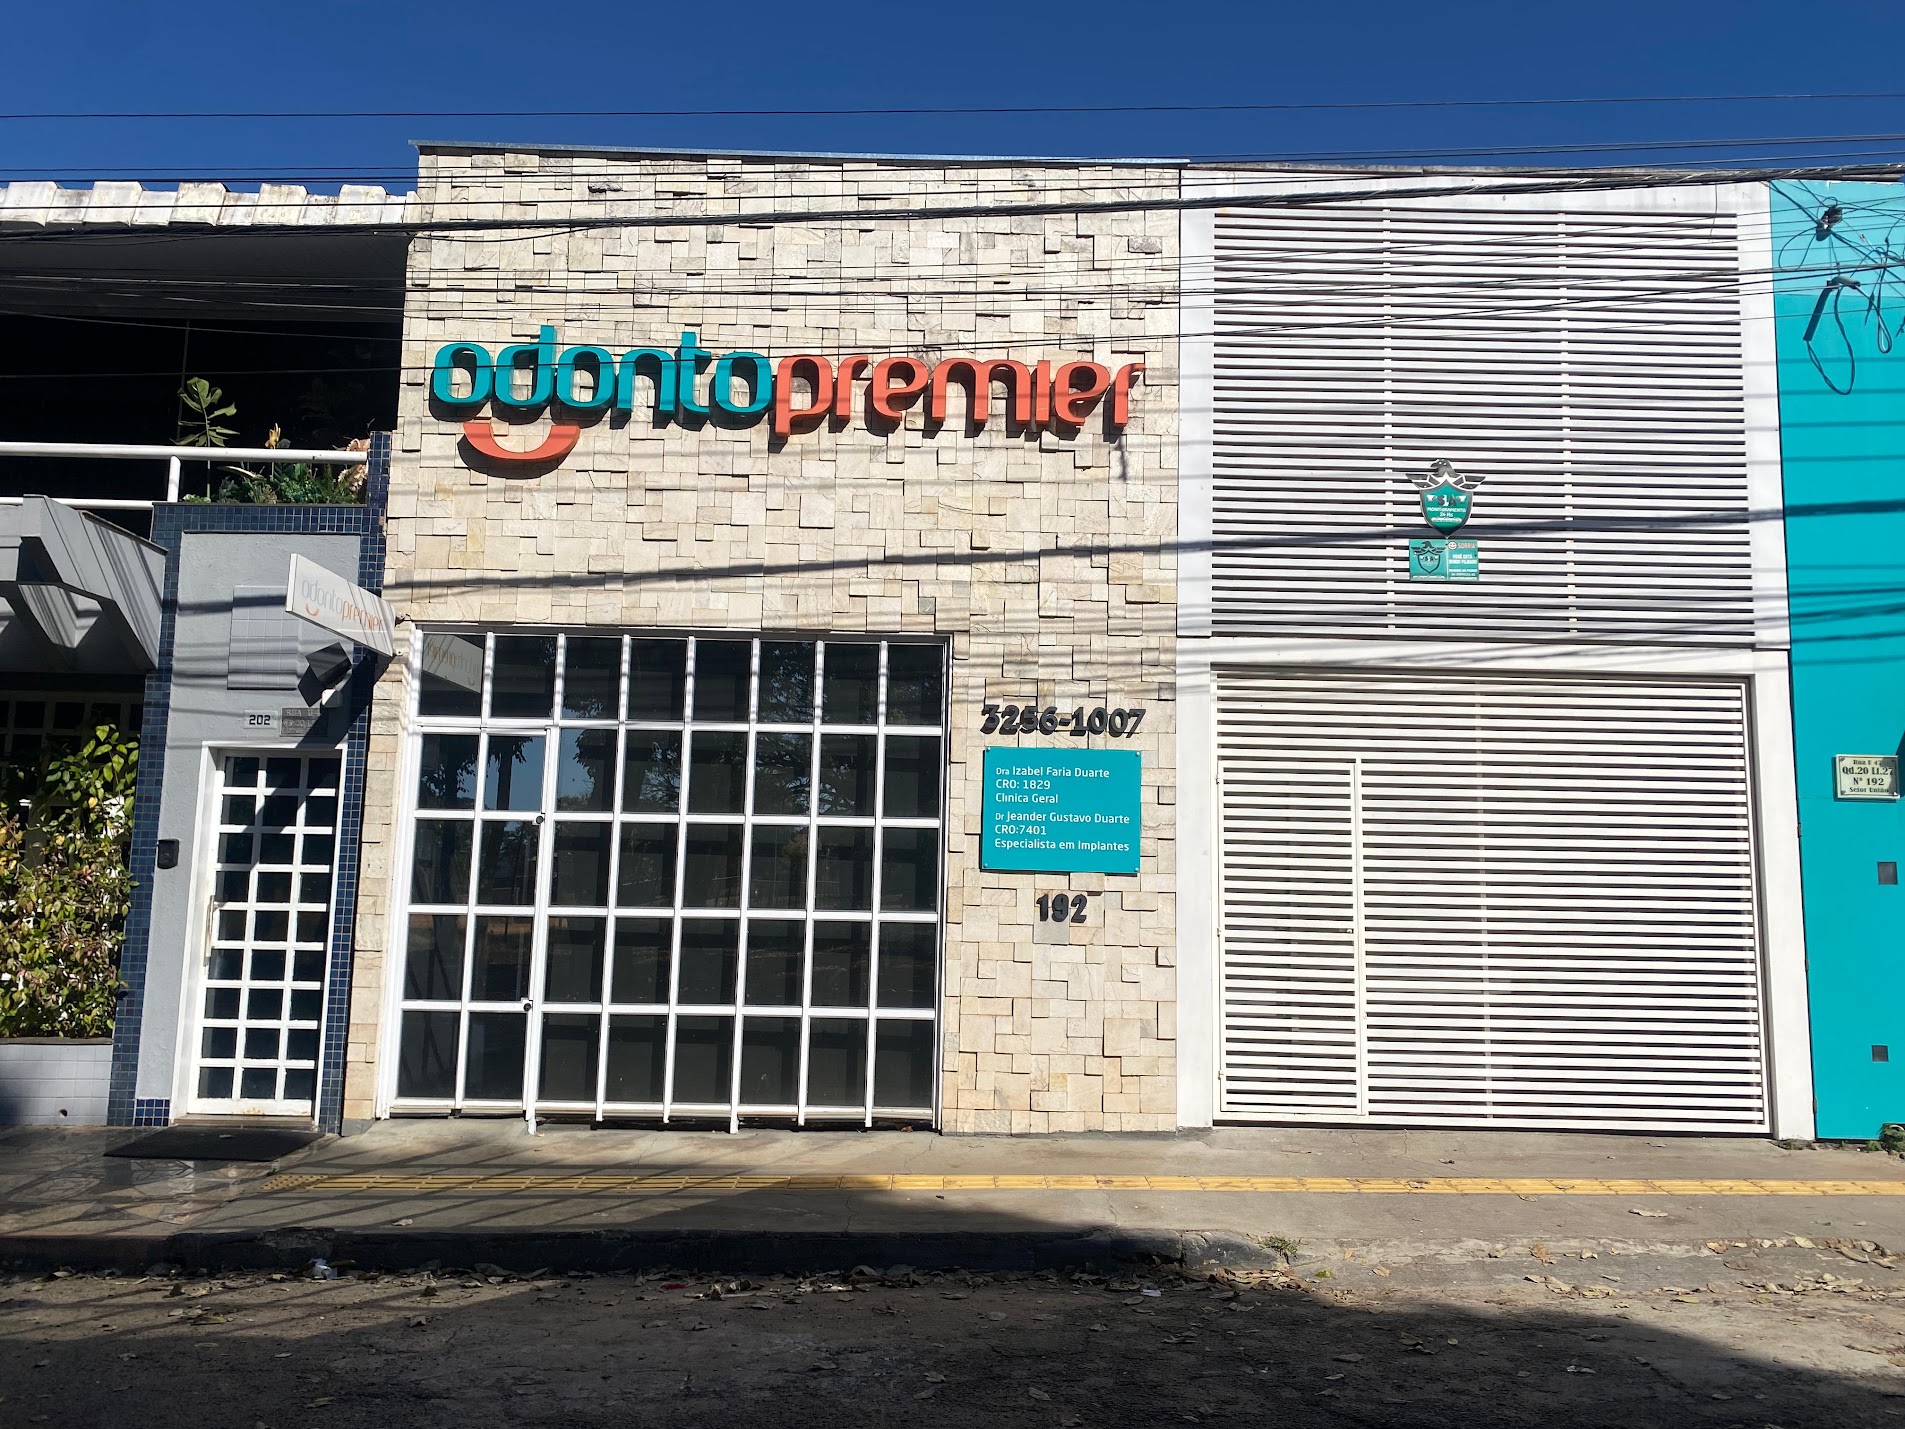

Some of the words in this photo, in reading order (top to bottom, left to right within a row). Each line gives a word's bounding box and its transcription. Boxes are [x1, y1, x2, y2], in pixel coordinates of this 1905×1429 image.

[429, 325, 1146, 438] odontopremier
[249, 714, 271, 726] 202
[980, 704, 1147, 738] 3256-1007
[996, 767, 1010, 775] Dra
[1012, 766, 1044, 776] Izabel
[1046, 766, 1072, 777] Faria
[1074, 767, 1110, 778] Duarte
[995, 779, 1020, 789] CRO:
[1022, 779, 1051, 790] 1829
[1867, 777, 1884, 785] 192
[1031, 793, 1059, 804] Geral
[995, 812, 1005, 820] Dr
[1006, 811, 1047, 822] Jeander
[1049, 812, 1092, 823] Gustavo
[1094, 813, 1130, 824] Duarte
[994, 838, 1057, 850] Especialista
[1058, 842, 1075, 850] em
[1077, 840, 1130, 852] Implantes
[1036, 893, 1088, 924] 192
